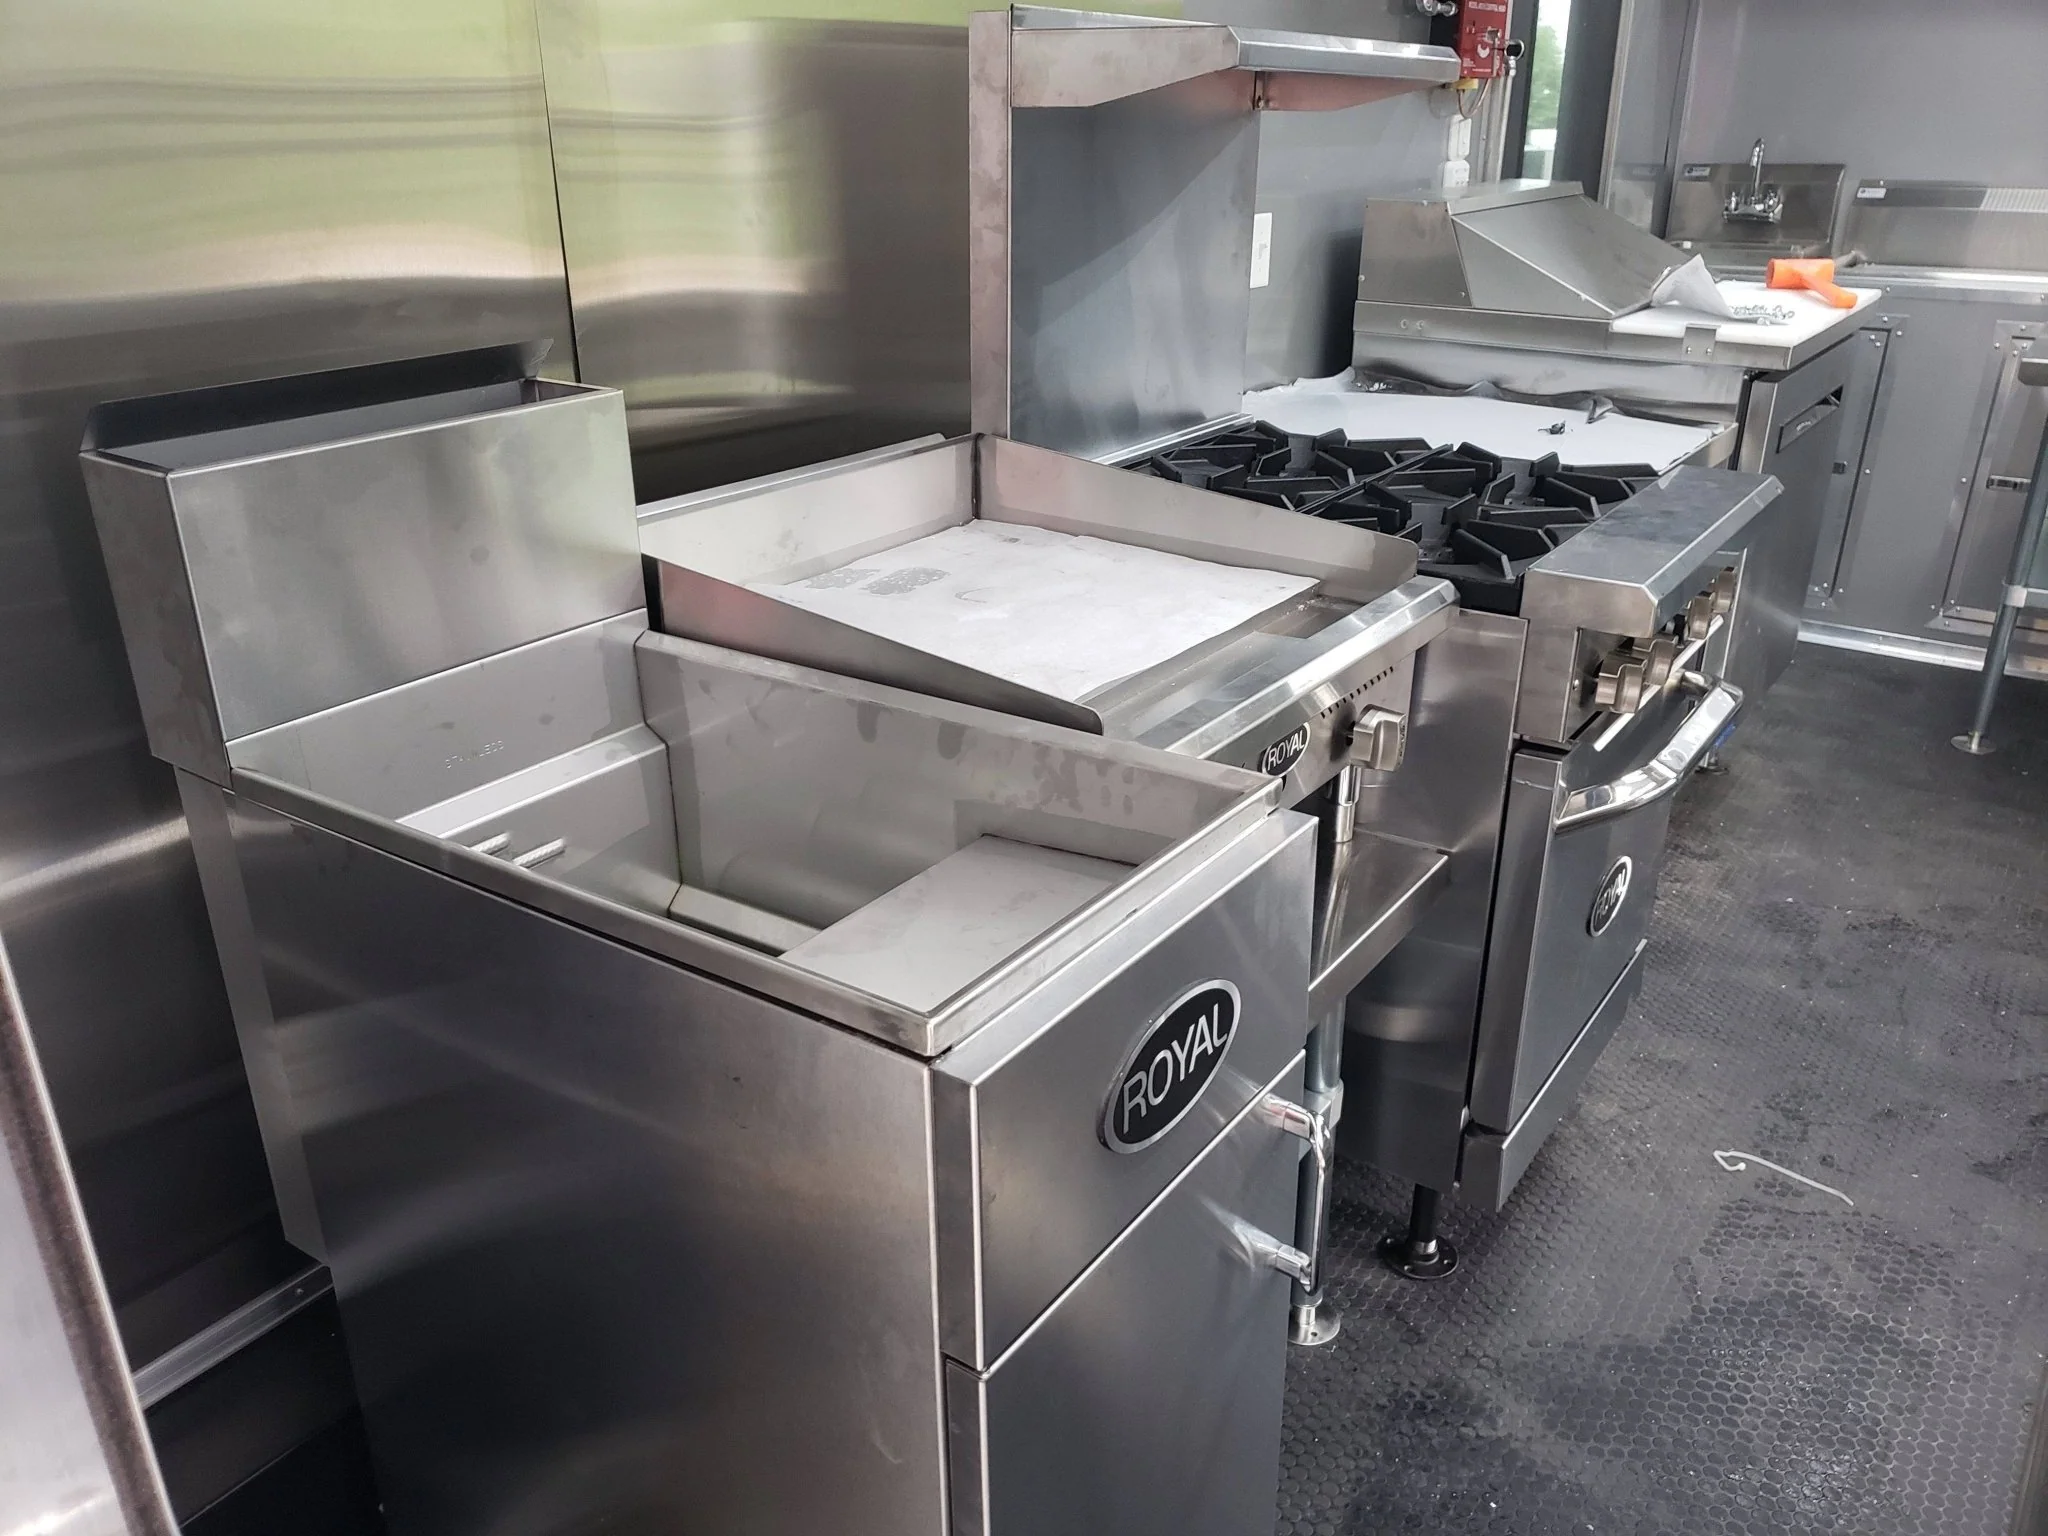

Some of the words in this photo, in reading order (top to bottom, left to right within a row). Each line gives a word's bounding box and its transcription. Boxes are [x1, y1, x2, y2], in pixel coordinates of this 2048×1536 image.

[445, 740, 504, 769] STALESS
[1266, 728, 1306, 771] ROYAL
[1594, 867, 1626, 925] ROYAL
[1122, 1002, 1228, 1135] ROYAL
